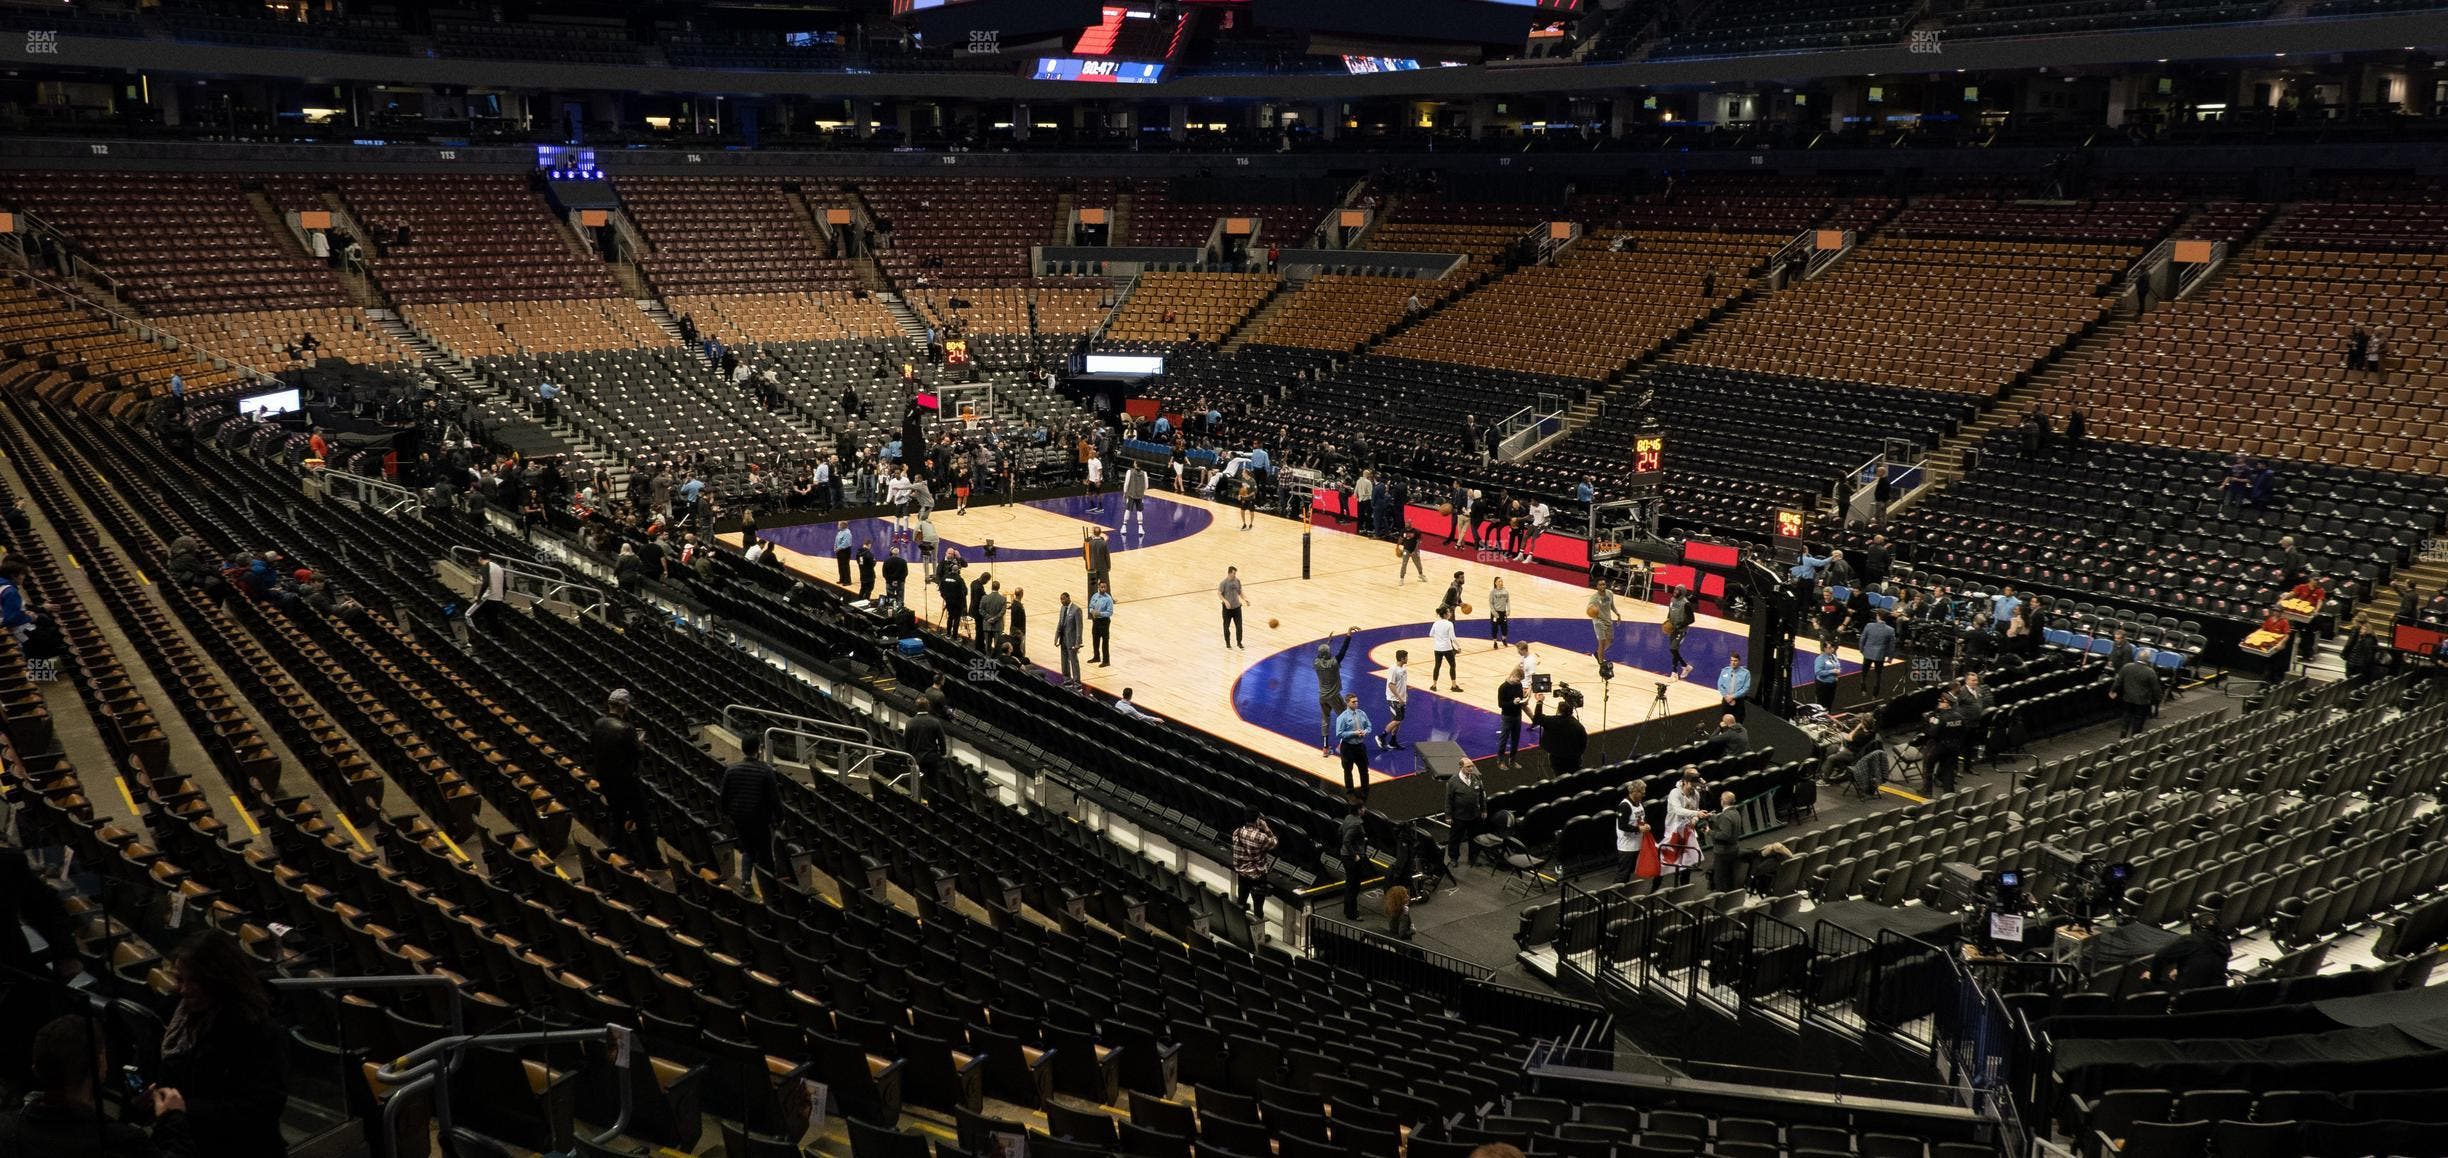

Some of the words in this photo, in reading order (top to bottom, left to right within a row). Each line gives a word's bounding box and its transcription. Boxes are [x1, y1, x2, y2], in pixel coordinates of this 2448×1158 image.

[90, 145, 109, 154] 112
[439, 151, 456, 160] 113
[687, 154, 701, 162] 114
[942, 156, 956, 164] 115
[1236, 157, 1249, 166] 116
[948, 350, 965, 362] 24
[1637, 438, 1661, 452] 80:46
[1638, 452, 1658, 472] 24
[1782, 523, 1797, 536] 24
